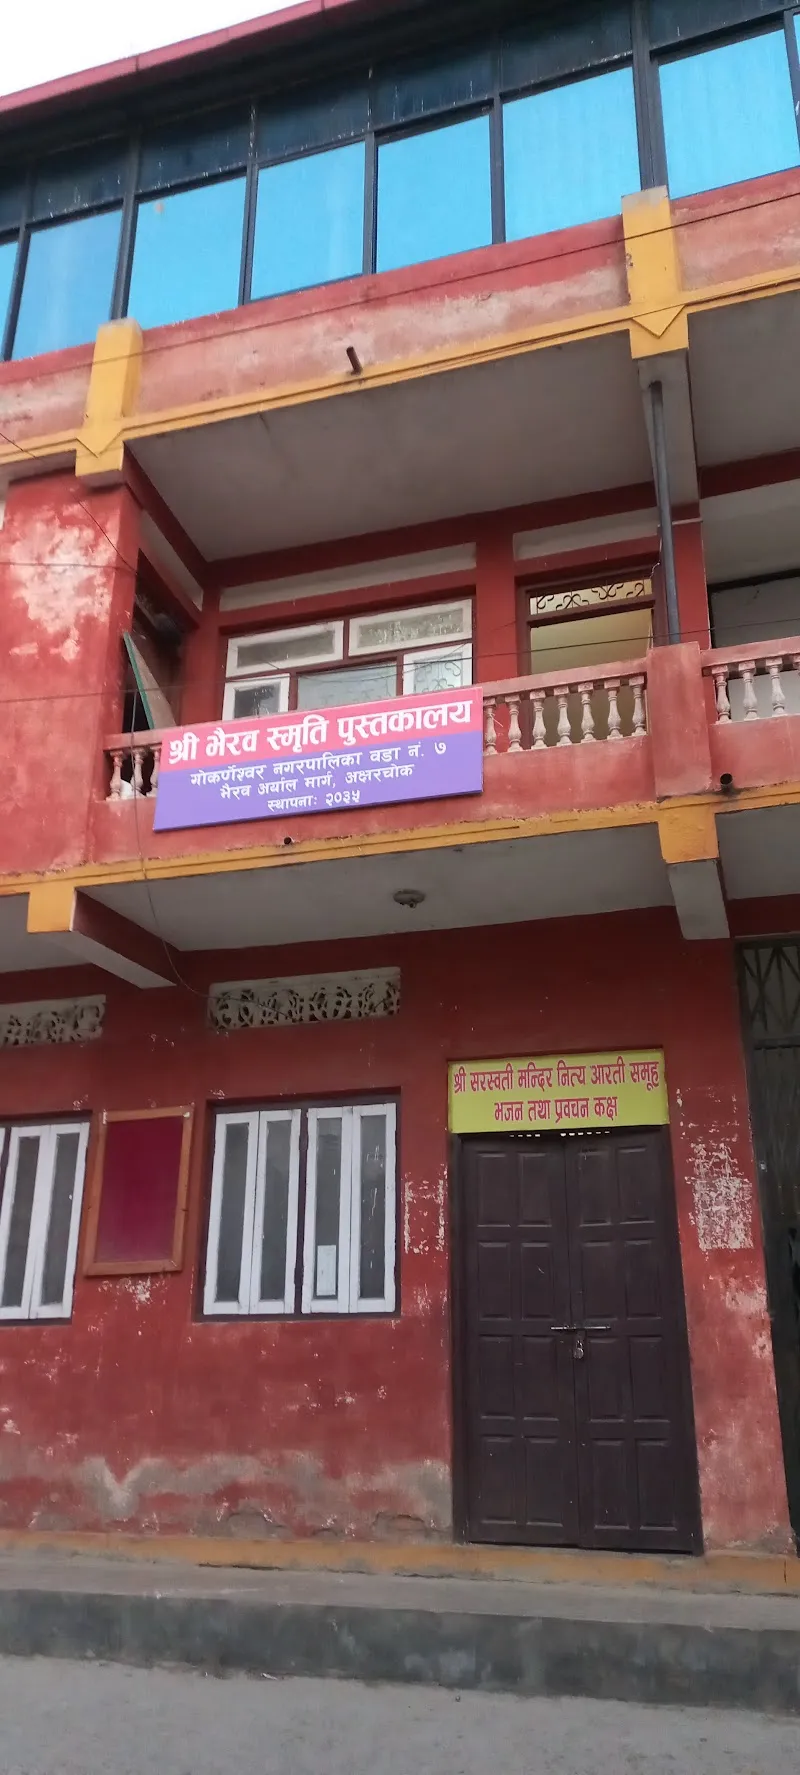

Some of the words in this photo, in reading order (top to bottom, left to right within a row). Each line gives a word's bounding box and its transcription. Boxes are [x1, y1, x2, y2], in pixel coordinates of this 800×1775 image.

[169, 733, 200, 764] श्री
[206, 724, 258, 757] भैरव
[266, 714, 328, 753] स्मृति
[337, 700, 473, 746] पुस्तकालय
[273, 751, 363, 776] नगरपालिका
[370, 748, 399, 763] वडा
[408, 744, 425, 758] नं.
[434, 741, 447, 755] ७
[220, 783, 250, 800] भैरव
[258, 777, 297, 795] अर्याल
[304, 772, 336, 789] मार्ग,
[344, 764, 414, 784] अक्षरचोक
[326, 790, 360, 805] २०३५
[454, 1066, 466, 1094] श्री
[470, 1063, 513, 1091] सरस्वती
[518, 1062, 553, 1092] मन्दिर
[557, 1060, 585, 1087] नित्य
[590, 1056, 625, 1084] आरती
[629, 1062, 659, 1091] समूह
[494, 1101, 523, 1121] भजन
[528, 1100, 551, 1121] तथा
[555, 1098, 589, 1123] प्रवचन
[593, 1096, 618, 1120] कक्ष
